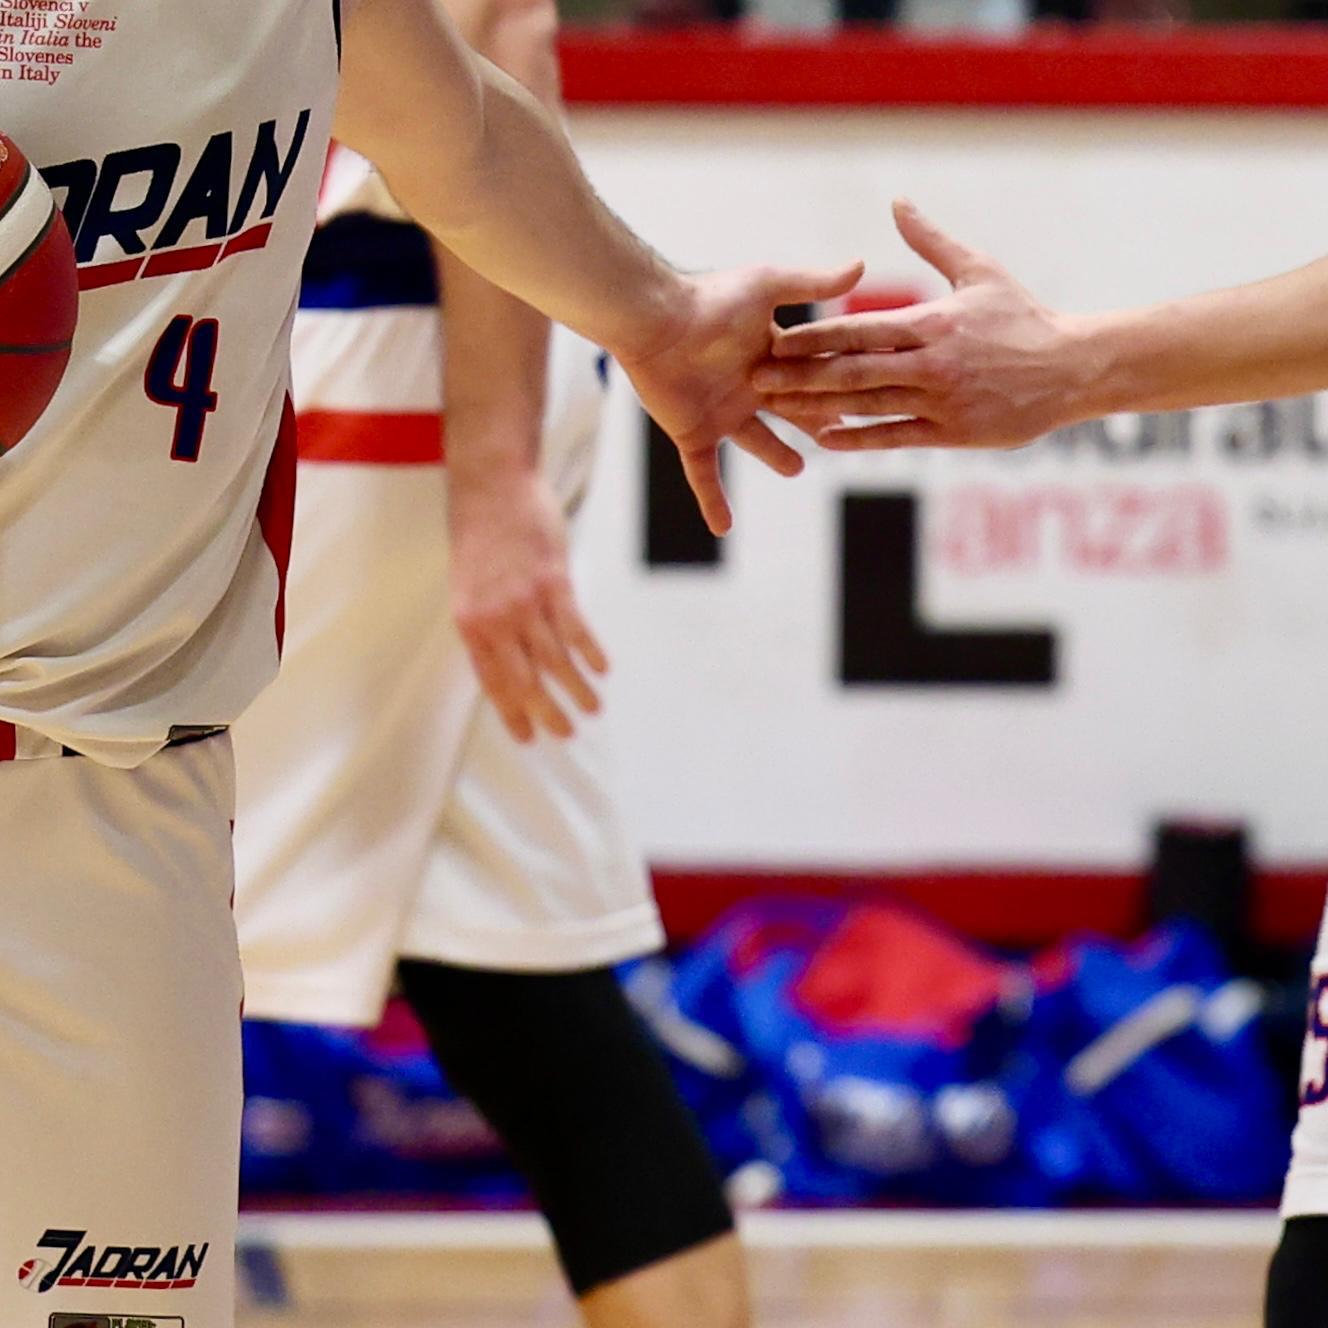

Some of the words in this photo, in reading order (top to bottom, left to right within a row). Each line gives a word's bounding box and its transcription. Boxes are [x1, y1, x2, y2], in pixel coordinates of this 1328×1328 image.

[79, 1, 90, 12] v
[54, 14, 118, 31] Sloveni
[19, 30, 71, 46] Italia
[74, 33, 103, 49] the
[18, 65, 61, 86] Italy
[143, 313, 220, 464] 4
[35, 1228, 210, 1294] JADRAN
